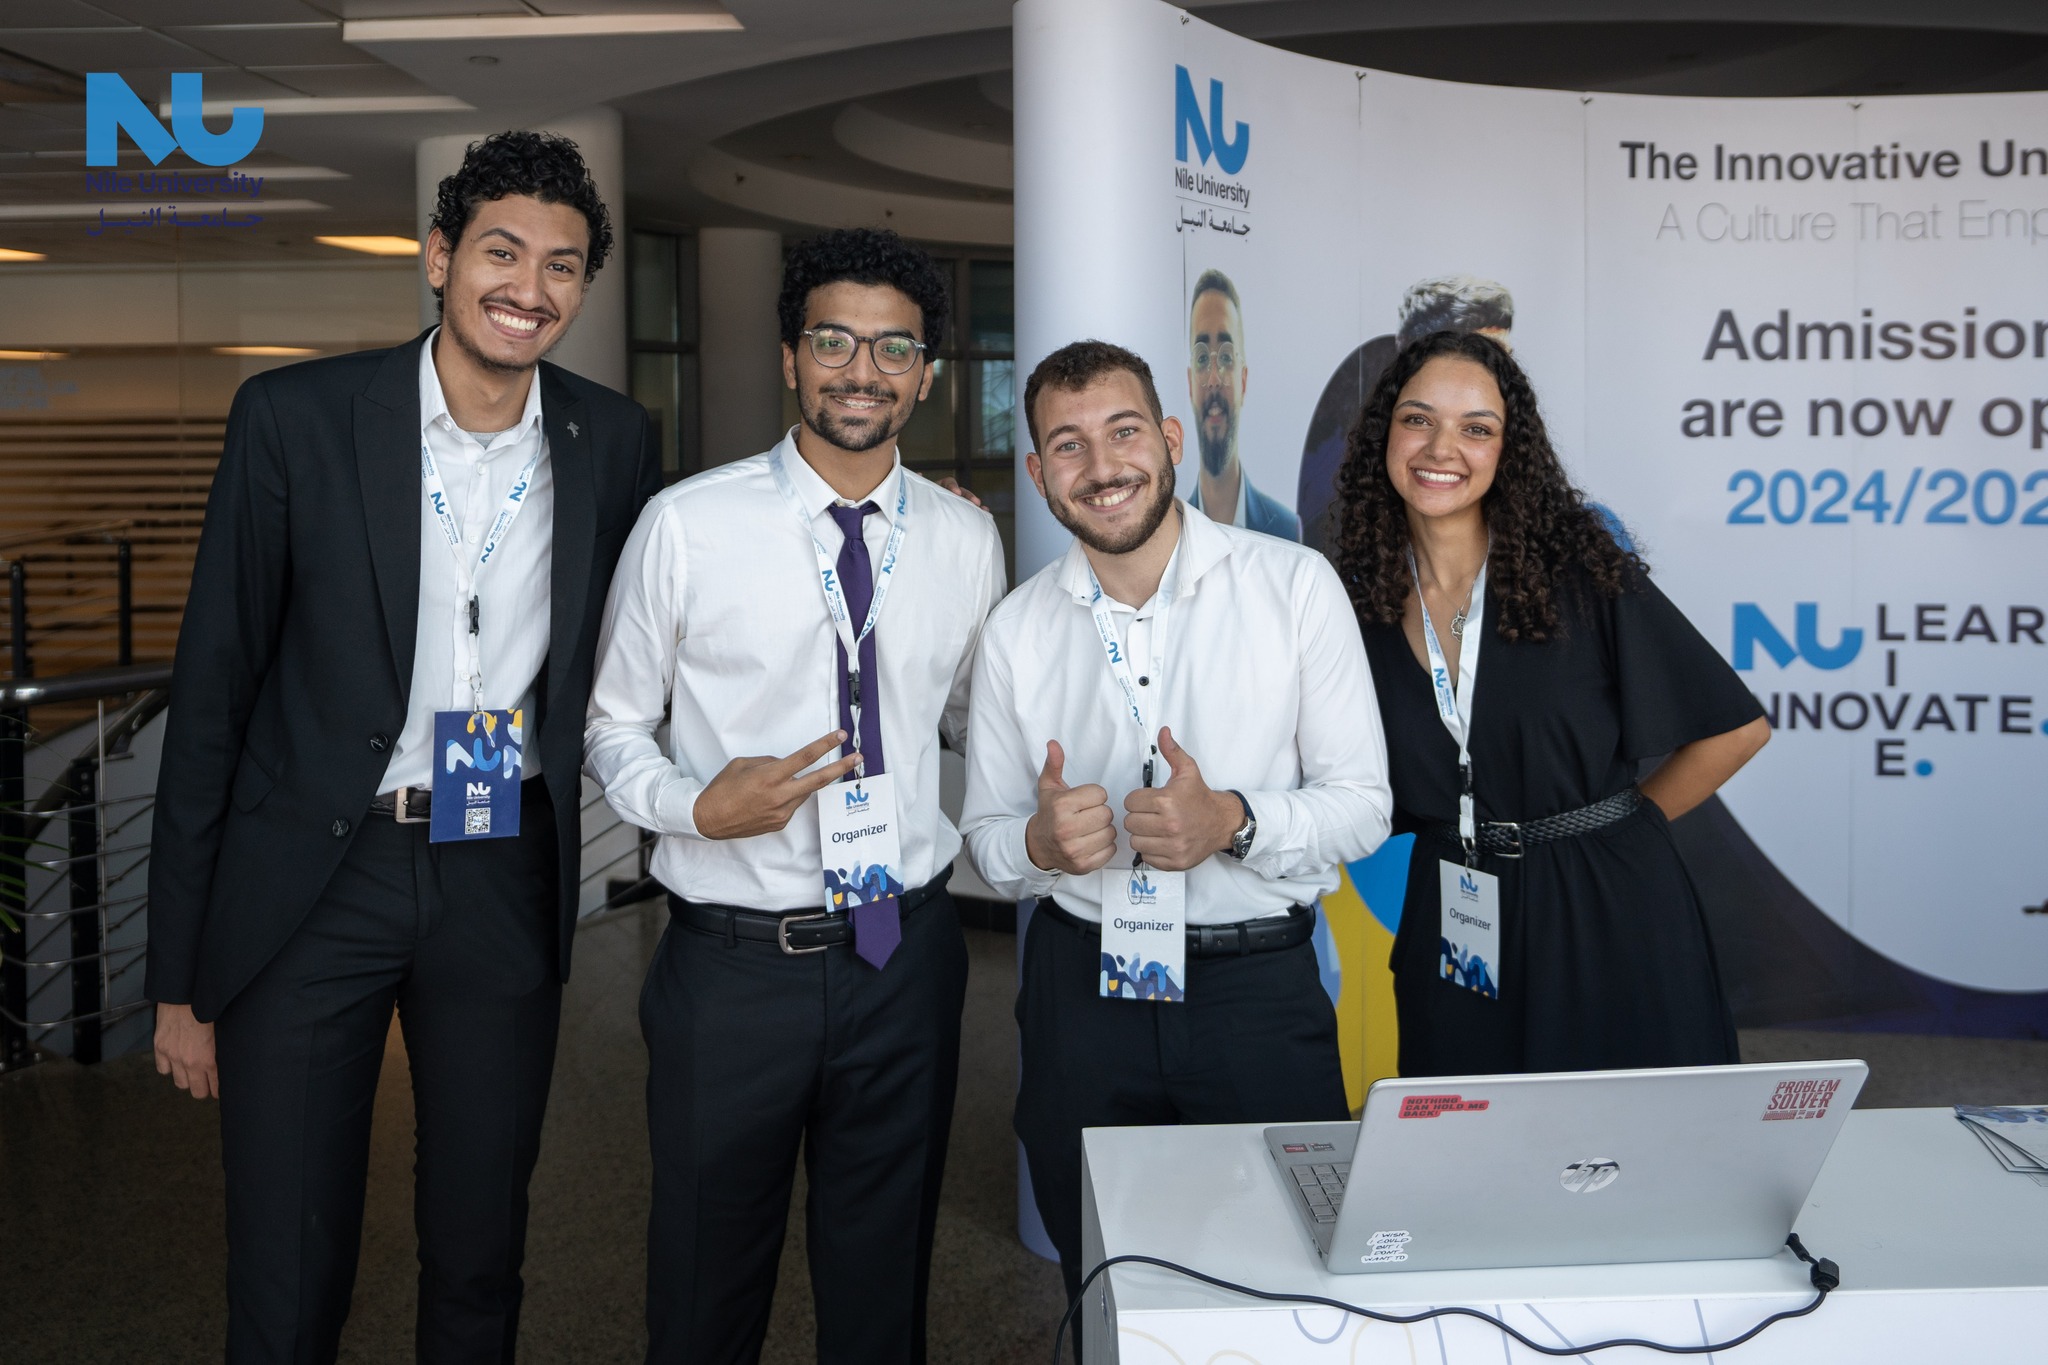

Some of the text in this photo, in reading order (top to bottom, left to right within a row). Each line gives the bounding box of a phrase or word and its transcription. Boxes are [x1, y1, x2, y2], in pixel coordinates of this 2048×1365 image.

[1175, 63, 1249, 175] NU
[1620, 139, 2048, 181] The Innovative Un
[1175, 166, 1250, 208] Nile University
[1656, 202, 1686, 241] A
[1696, 202, 1837, 242] Culture
[1849, 201, 1943, 241] That
[1681, 397, 1785, 438] are
[1809, 397, 1953, 438] now
[430, 491, 446, 515] NU
[822, 569, 836, 592] NU
[1876, 603, 2045, 644] LEAR
[1732, 602, 1864, 671] NU
[1108, 641, 1122, 664] NU
[1433, 667, 1446, 688] NU
[466, 782, 491, 796] NU
[845, 788, 869, 806] NU
[831, 823, 888, 844] Organizer
[1113, 917, 1174, 933] Organizer
[1449, 907, 1491, 931] Organizer
[1775, 1079, 1841, 1094] PROBLEM
[1407, 1097, 1458, 1105] NOTHING
[1767, 1092, 1833, 1110] SOLVER
